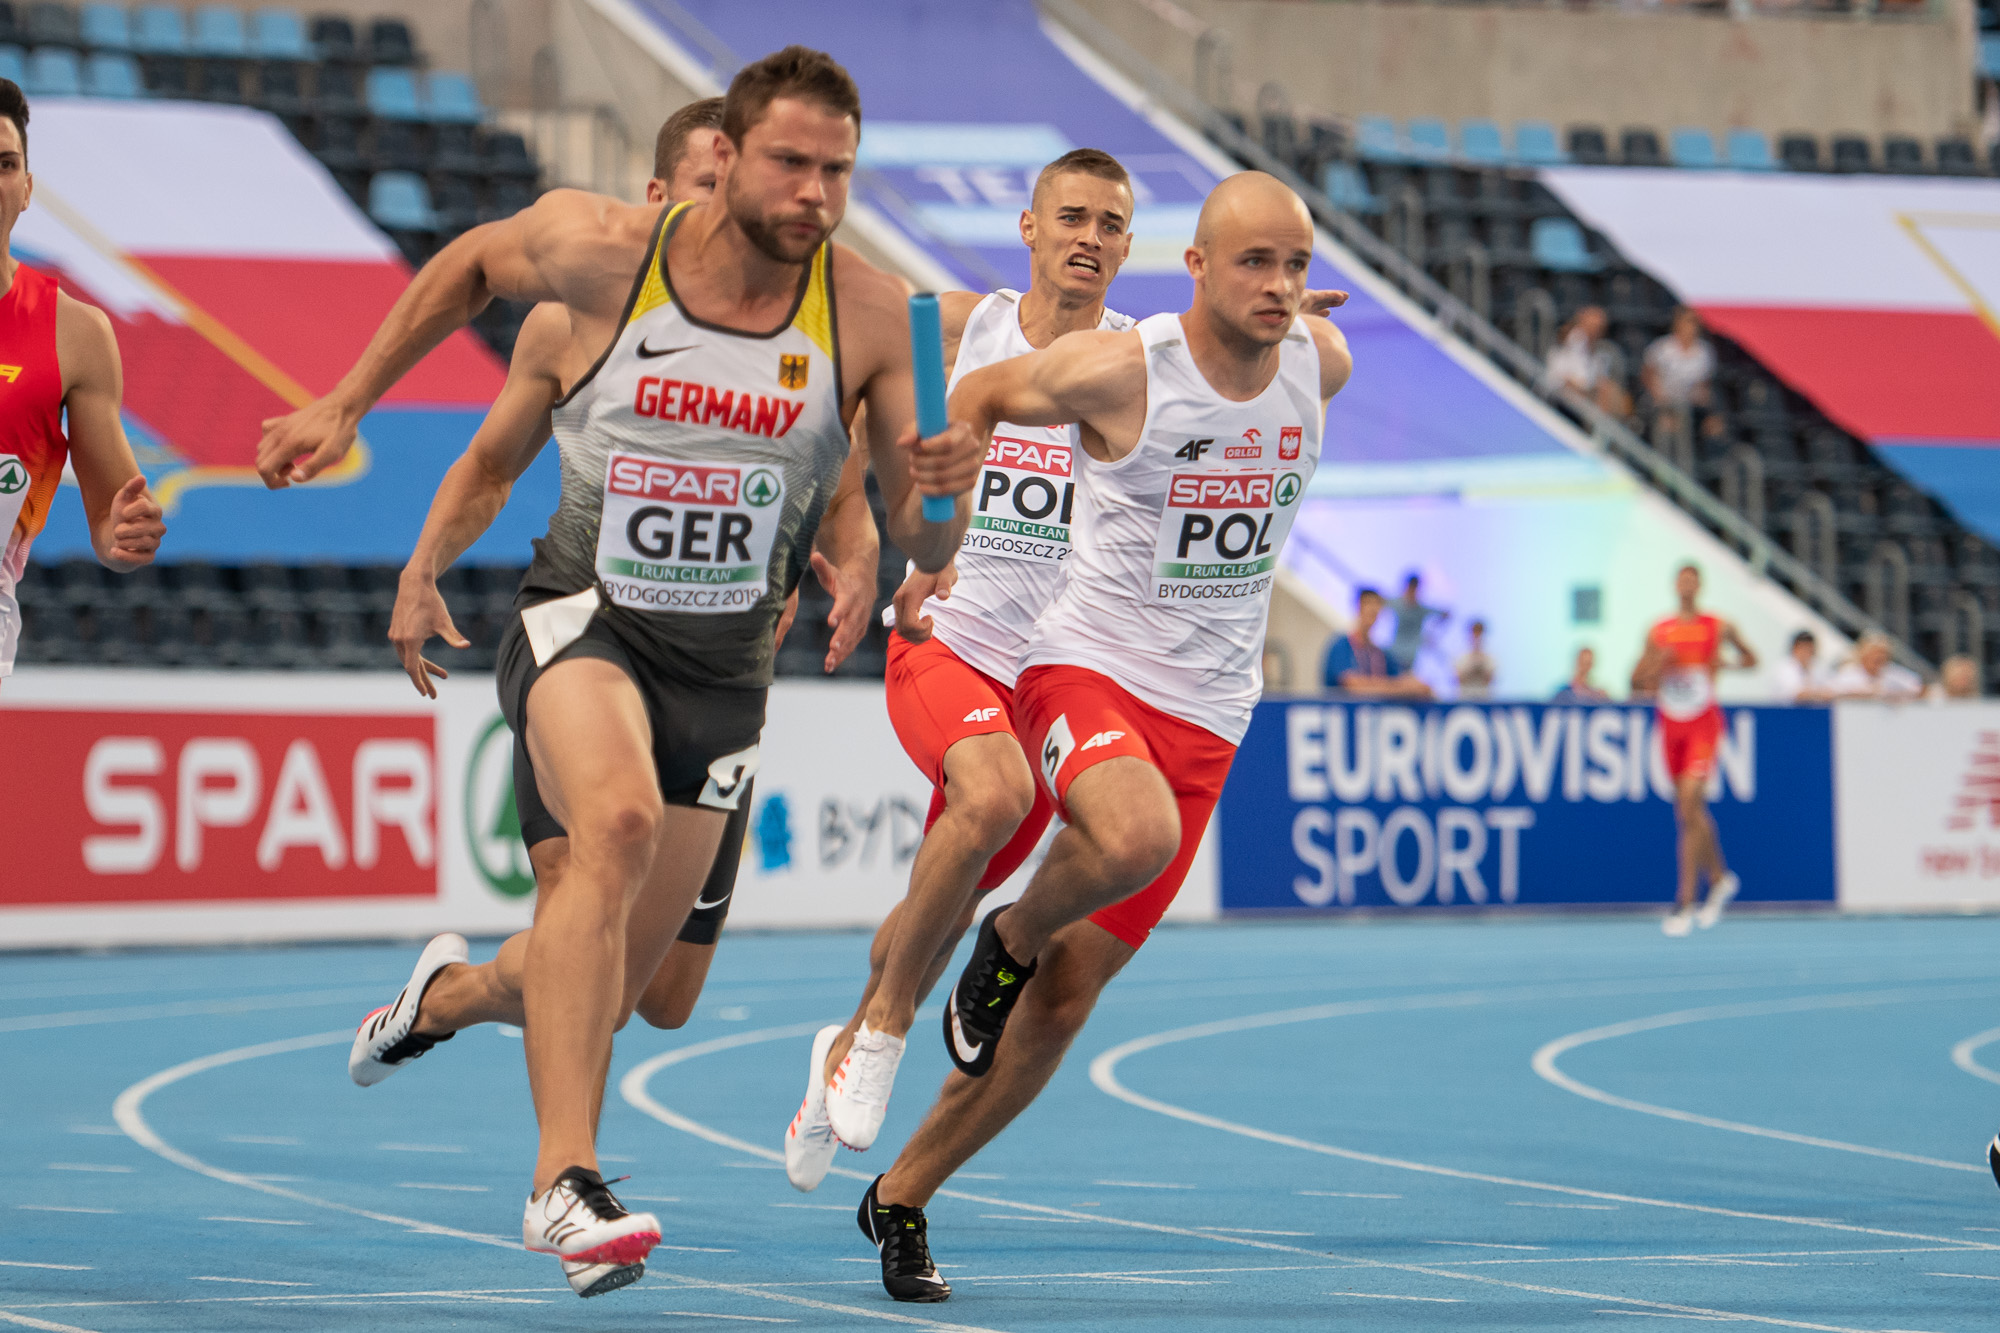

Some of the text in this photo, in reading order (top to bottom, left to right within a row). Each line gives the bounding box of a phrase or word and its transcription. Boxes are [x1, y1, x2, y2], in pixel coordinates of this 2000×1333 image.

[634, 375, 805, 438] GERMANY
[1174, 438, 1215, 461] 4F
[1226, 447, 1260, 458] ORLEN
[613, 461, 737, 501] SPAR
[1171, 478, 1271, 505] SPAR
[626, 505, 753, 564] GER
[984, 517, 1066, 540] I RUN CLEAN
[1176, 512, 1274, 560] POL
[961, 533, 1055, 559] BYDGOSZCZ
[632, 563, 732, 582] I RUN CLEAN
[1184, 562, 1258, 577] I RUN CLEAN
[603, 580, 762, 607] BYDGOSZCZ 2019
[1158, 583, 1249, 599] BYDGOSZCZ
[962, 707, 1001, 723] 4F
[1080, 730, 1126, 752] 4F
[80, 735, 439, 874] SPAR
[1291, 806, 1536, 904] SPORT
